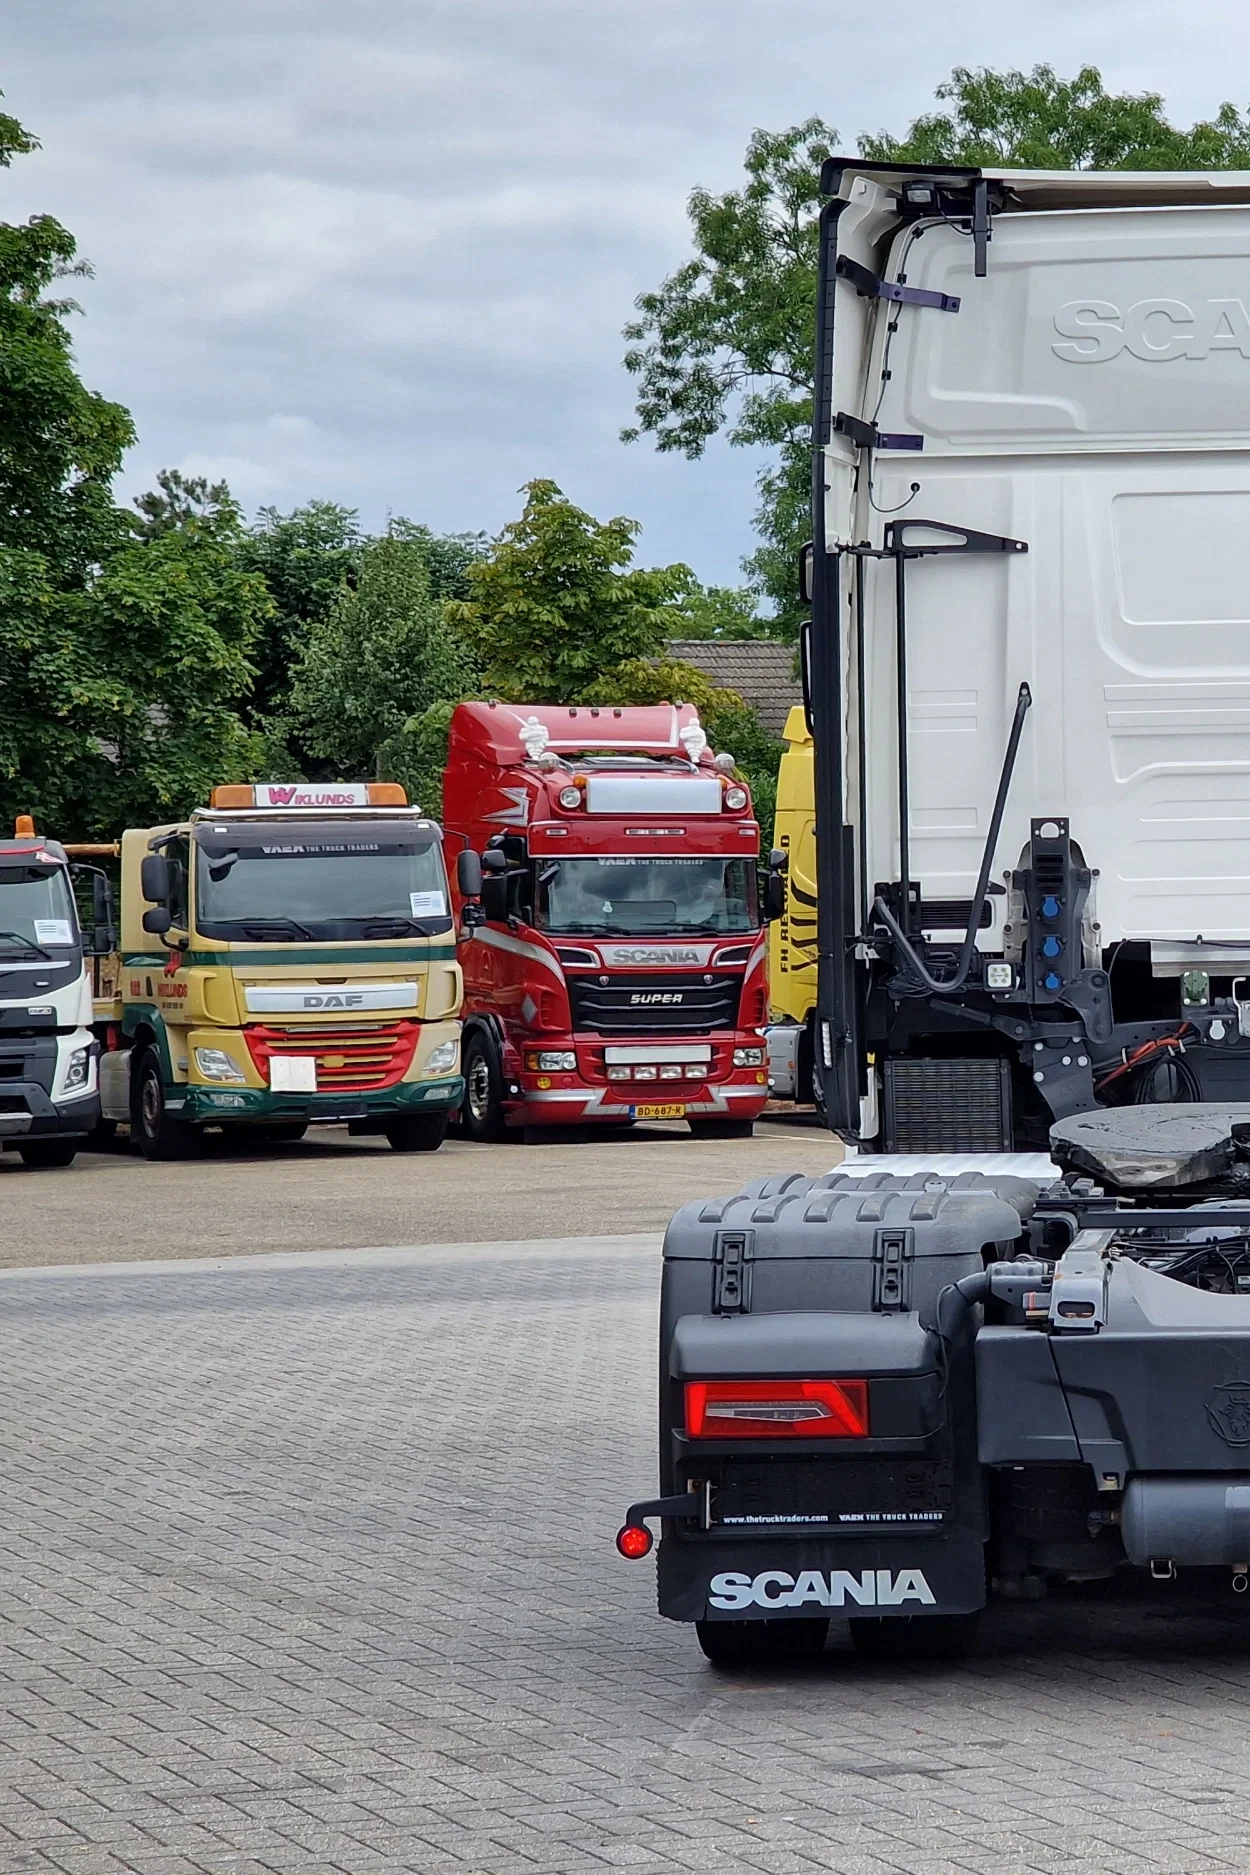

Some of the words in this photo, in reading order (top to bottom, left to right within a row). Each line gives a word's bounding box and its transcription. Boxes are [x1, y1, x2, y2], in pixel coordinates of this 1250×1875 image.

[268, 786, 355, 805] WIKLUNDS
[613, 948, 700, 964] SCANIA
[780, 949, 789, 973] FH
[303, 995, 363, 1008] DAF
[630, 993, 684, 1004] SUPER
[723, 1515, 829, 1524] www.thetrucktraders.com
[865, 1513, 880, 1521] THE
[882, 1513, 907, 1521] TRUCK
[708, 1569, 937, 1610] SCANIA
